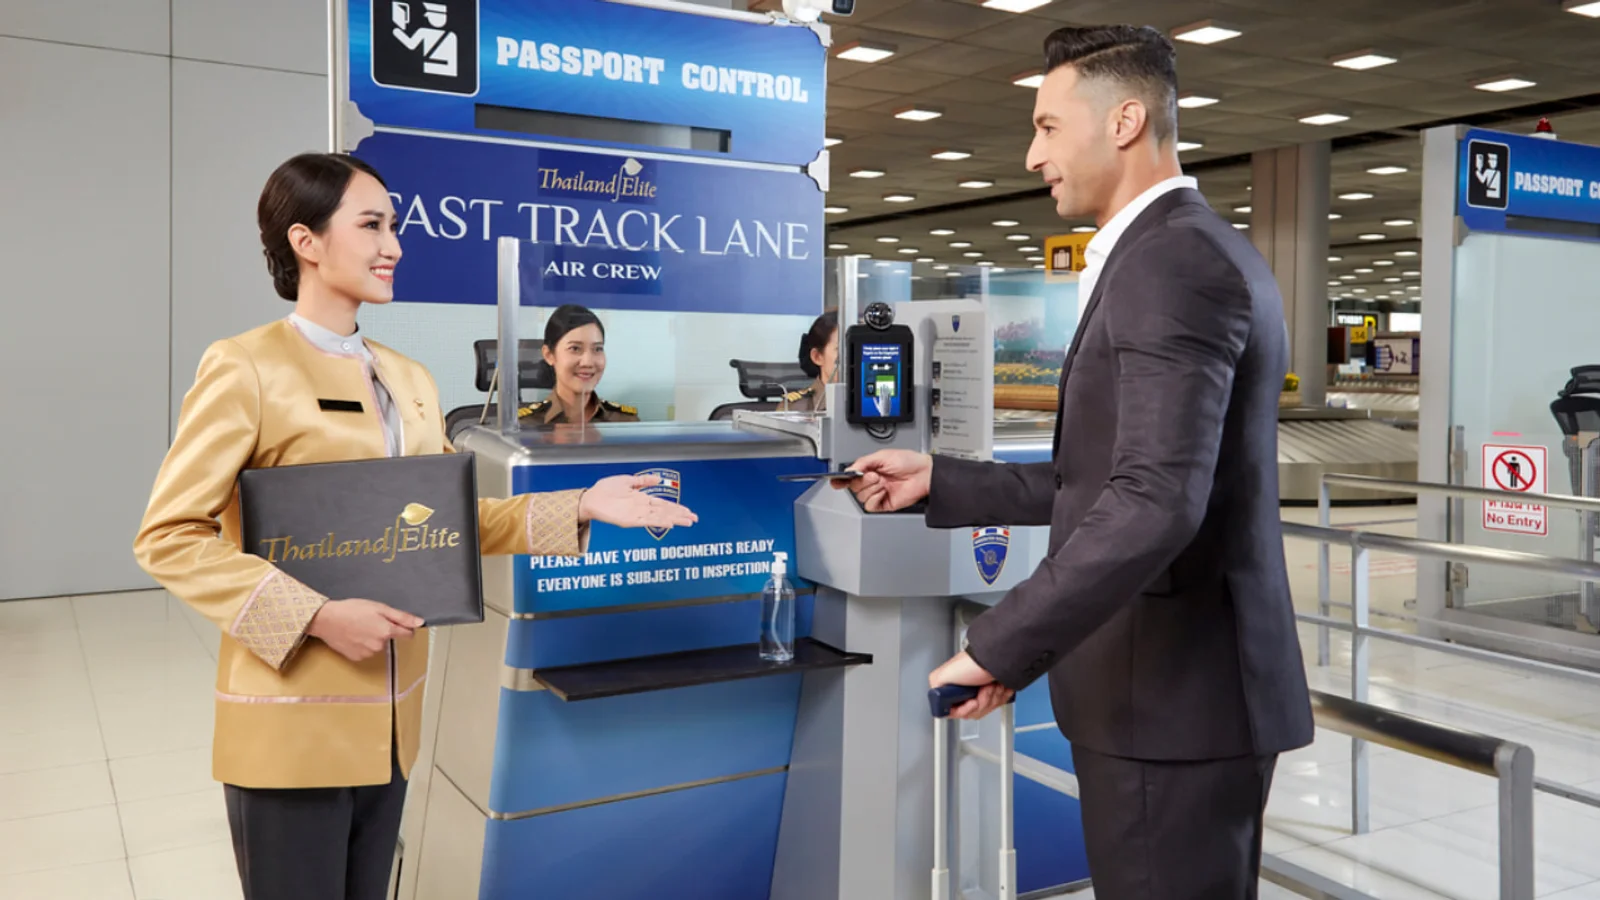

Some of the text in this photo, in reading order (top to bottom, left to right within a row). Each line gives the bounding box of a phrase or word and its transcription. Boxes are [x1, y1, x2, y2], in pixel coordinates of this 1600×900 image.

[496, 36, 809, 103] PASSPORT CONTROL
[538, 167, 657, 198] Thailand Elite
[1513, 171, 1583, 198] PASSPORT
[517, 202, 686, 253] TRACK
[695, 215, 810, 260] LANE
[543, 261, 662, 282] AIR CREW
[1487, 512, 1542, 530] No Entry
[259, 524, 461, 563] Thailand Elite
[530, 539, 775, 570] PLEASE HAVE YOUR DOCUMENTS READY
[537, 561, 770, 593] EVERYONE IS SUBJECT TO INSPECTION
